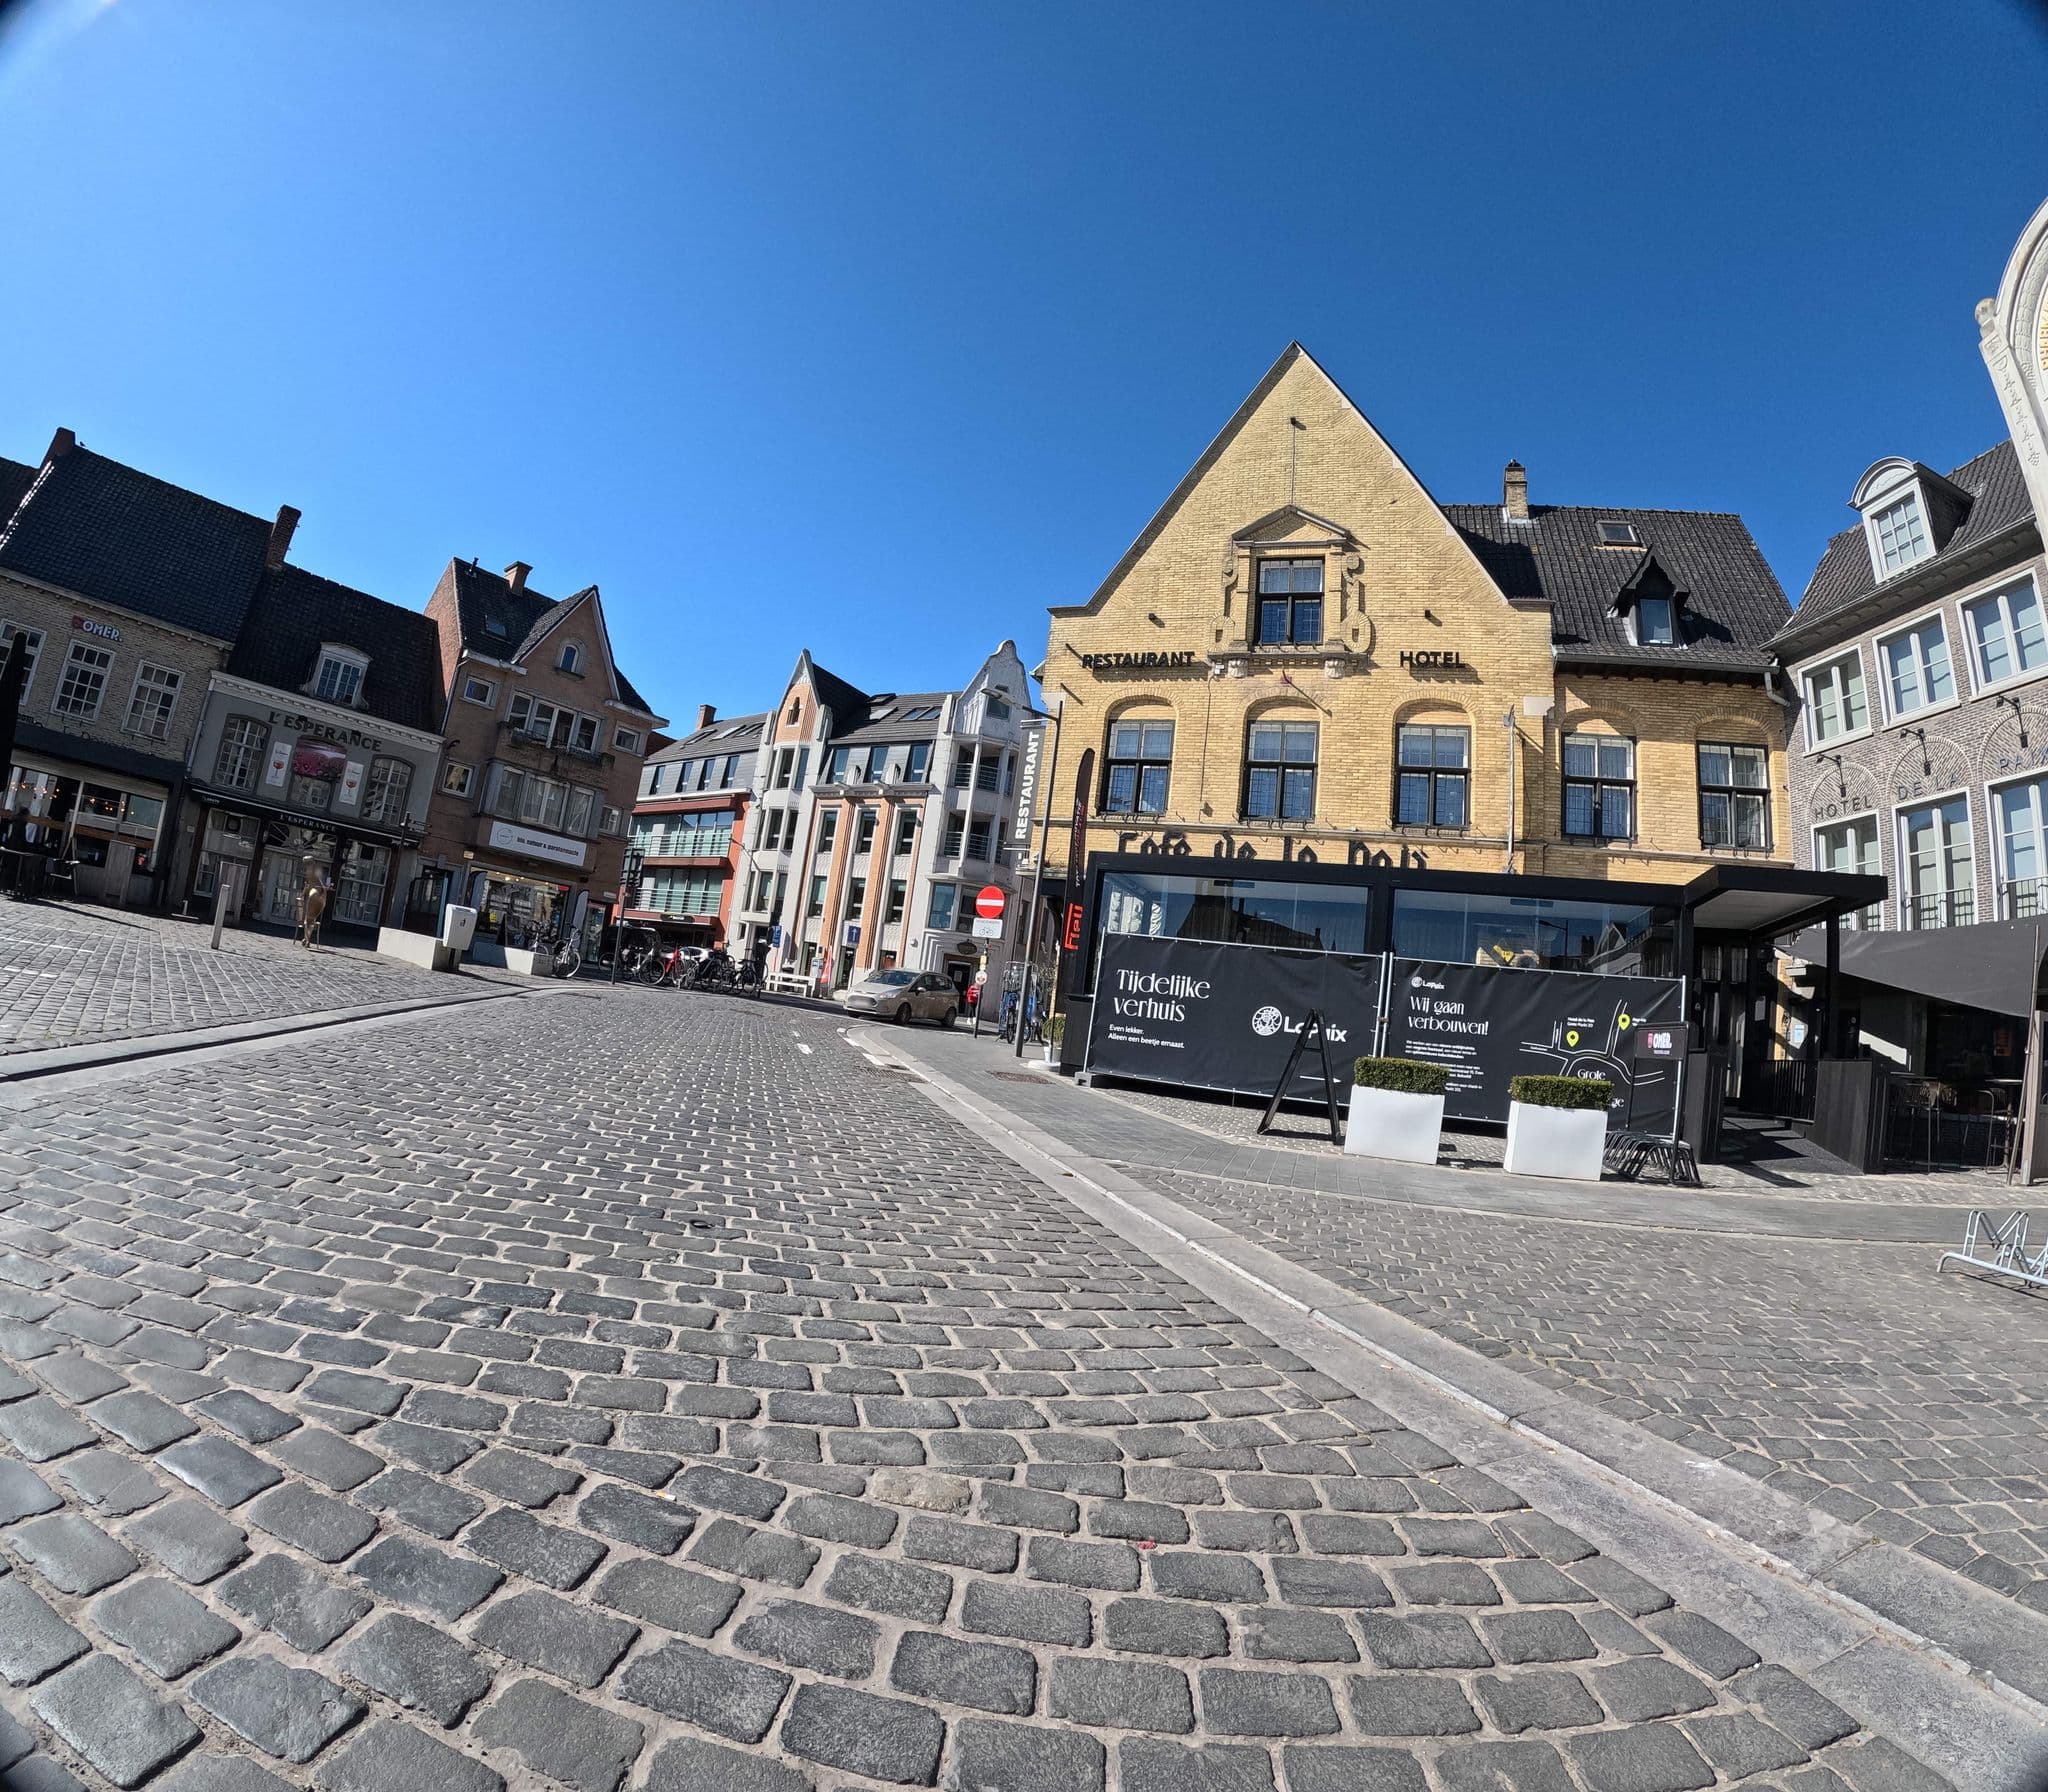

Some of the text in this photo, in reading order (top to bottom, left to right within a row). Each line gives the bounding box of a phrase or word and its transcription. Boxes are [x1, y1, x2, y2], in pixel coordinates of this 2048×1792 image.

[1081, 651, 1195, 669] RESTAURANT
[1400, 650, 1466, 669] HOTEL
[267, 711, 383, 752] L'ESPERANCE
[1015, 731, 1039, 841] RESTAURANT
[1814, 795, 1873, 822] HOTEL
[1899, 781, 1921, 801] DE
[1935, 772, 1961, 792] LA
[1116, 969, 1211, 1000] Tijdelijke
[1113, 997, 1185, 1022] verhuis
[1410, 995, 1465, 1015] Wij gaan
[1109, 1024, 1144, 1034] Even lekker.
[1408, 1016, 1489, 1035] verbouwen!
[1108, 1033, 1127, 1041] Alleen
[1141, 1037, 1160, 1046] beetje
